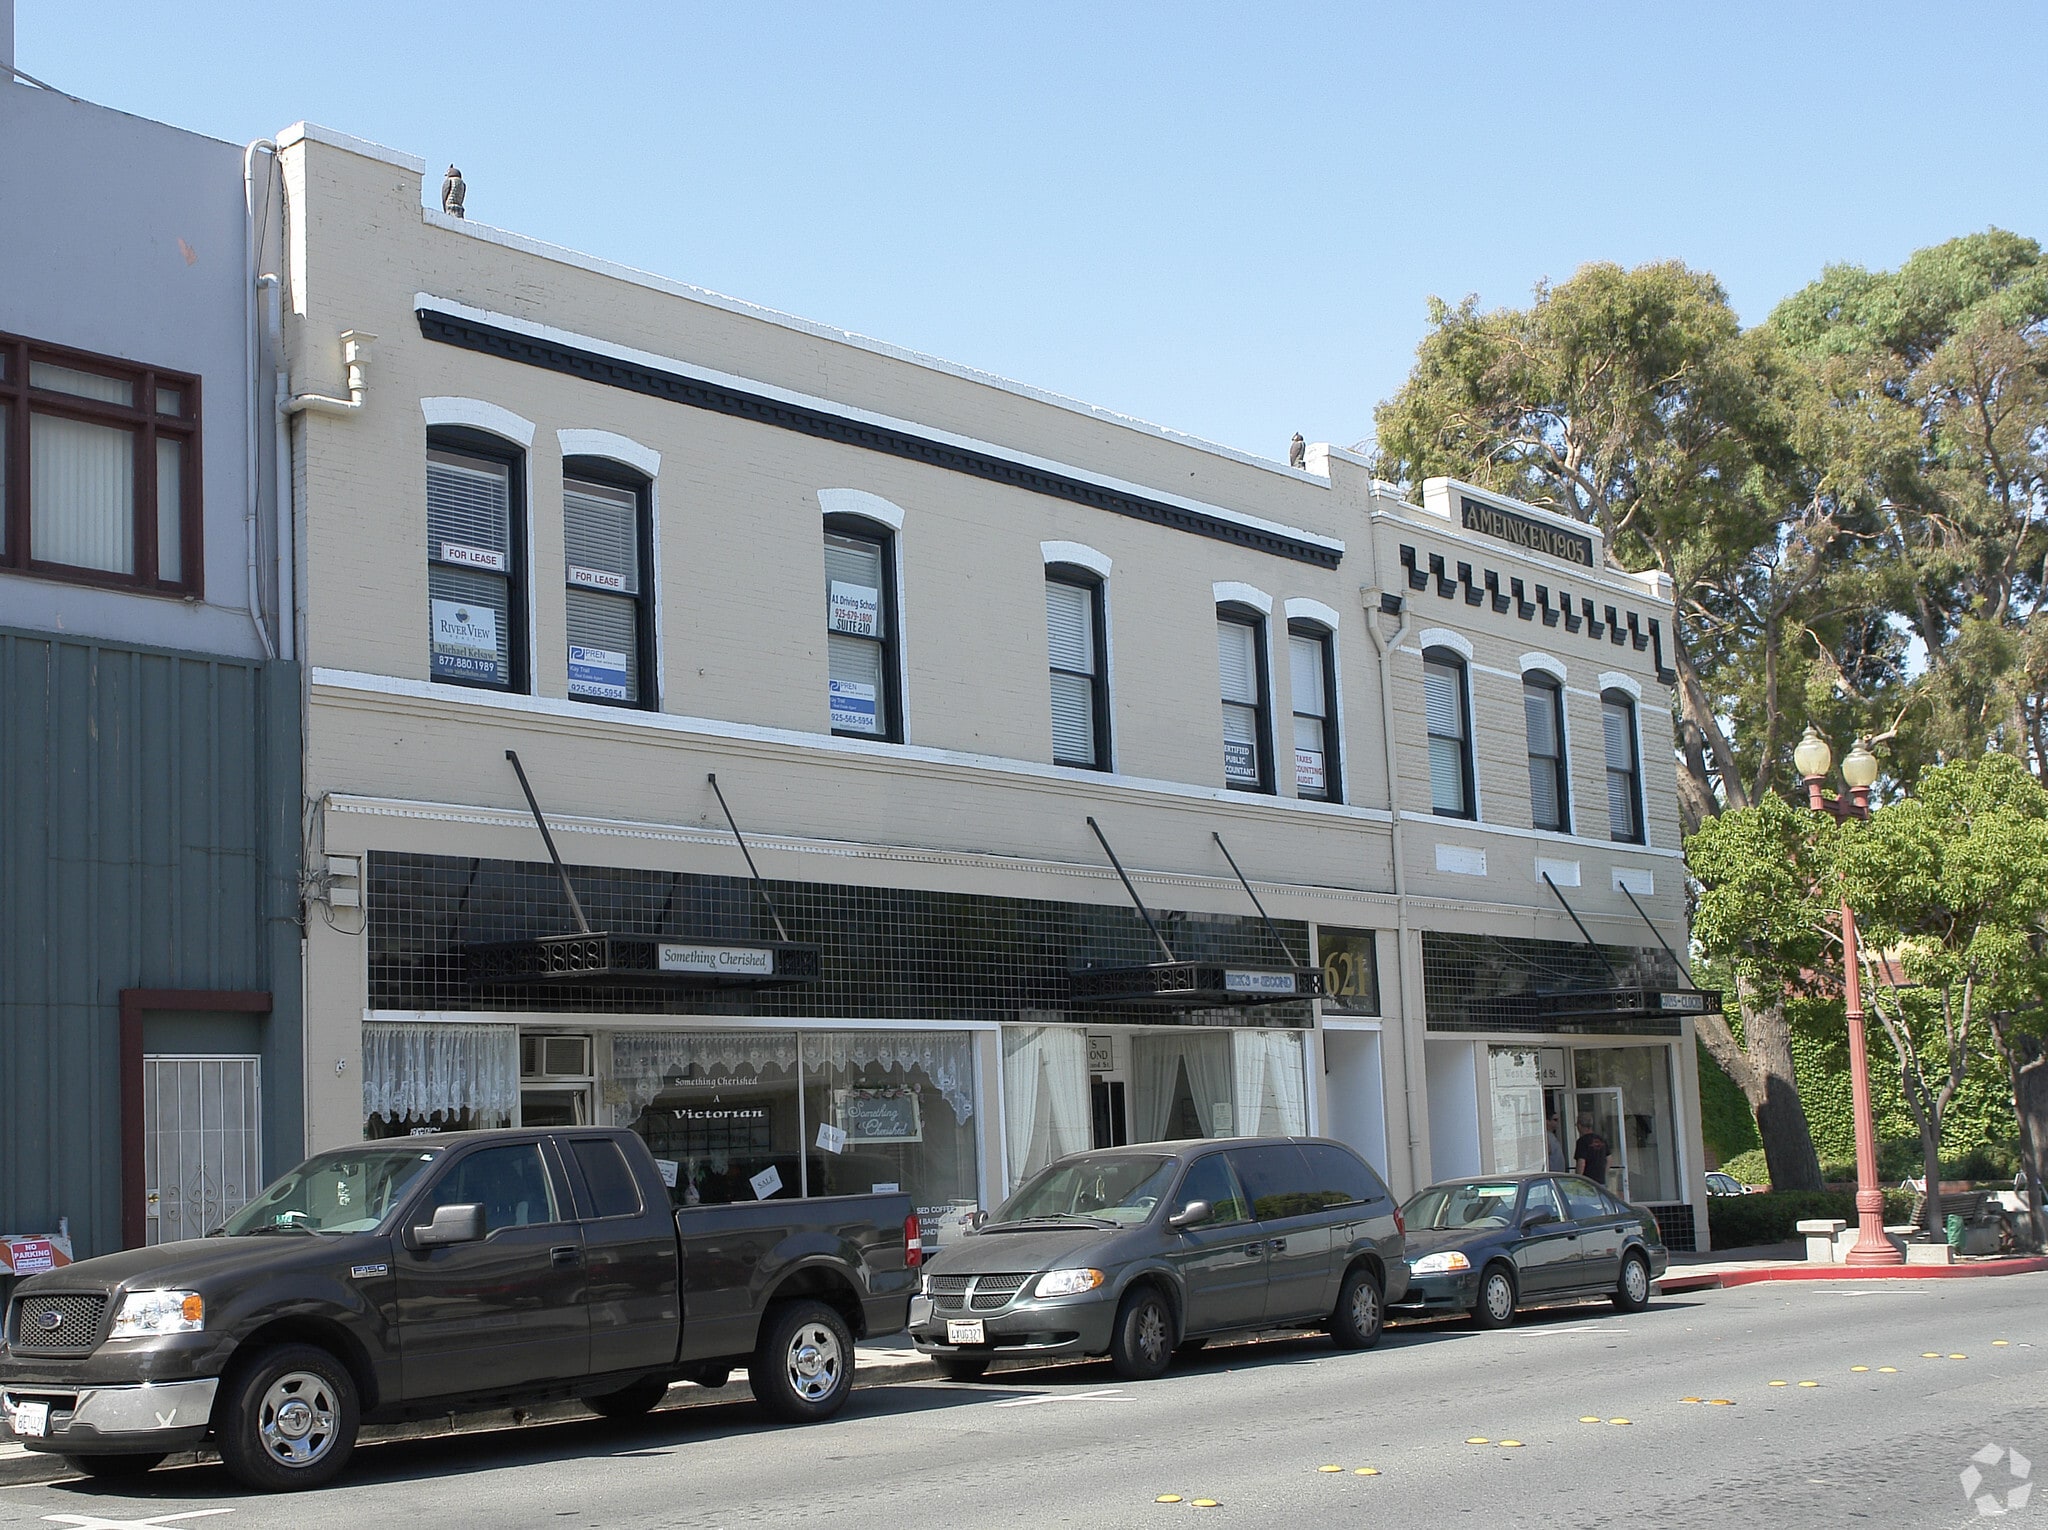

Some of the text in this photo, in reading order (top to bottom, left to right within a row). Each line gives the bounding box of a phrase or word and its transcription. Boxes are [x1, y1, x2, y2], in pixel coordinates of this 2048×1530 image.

[449, 548, 497, 565] FOR LEASE
[1552, 533, 1585, 564] 1905
[575, 571, 619, 587] FOR LEASE
[832, 594, 877, 611] A1 Driving School
[836, 619, 871, 634] SUITE 210
[438, 644, 467, 658] Michael
[438, 655, 494, 672] 877.880.1989
[1225, 755, 1246, 765] PUBLIC
[664, 949, 716, 969] Something
[1324, 952, 1368, 997] 621
[675, 1076, 758, 1089] Something Cherished
[713, 1094, 720, 1103] A
[672, 1108, 765, 1119] Victorian
[848, 1101, 899, 1121] Something
[863, 1119, 908, 1136] Cherished
[14, 1249, 50, 1259] PARKING
[25, 1243, 37, 1251] NO
